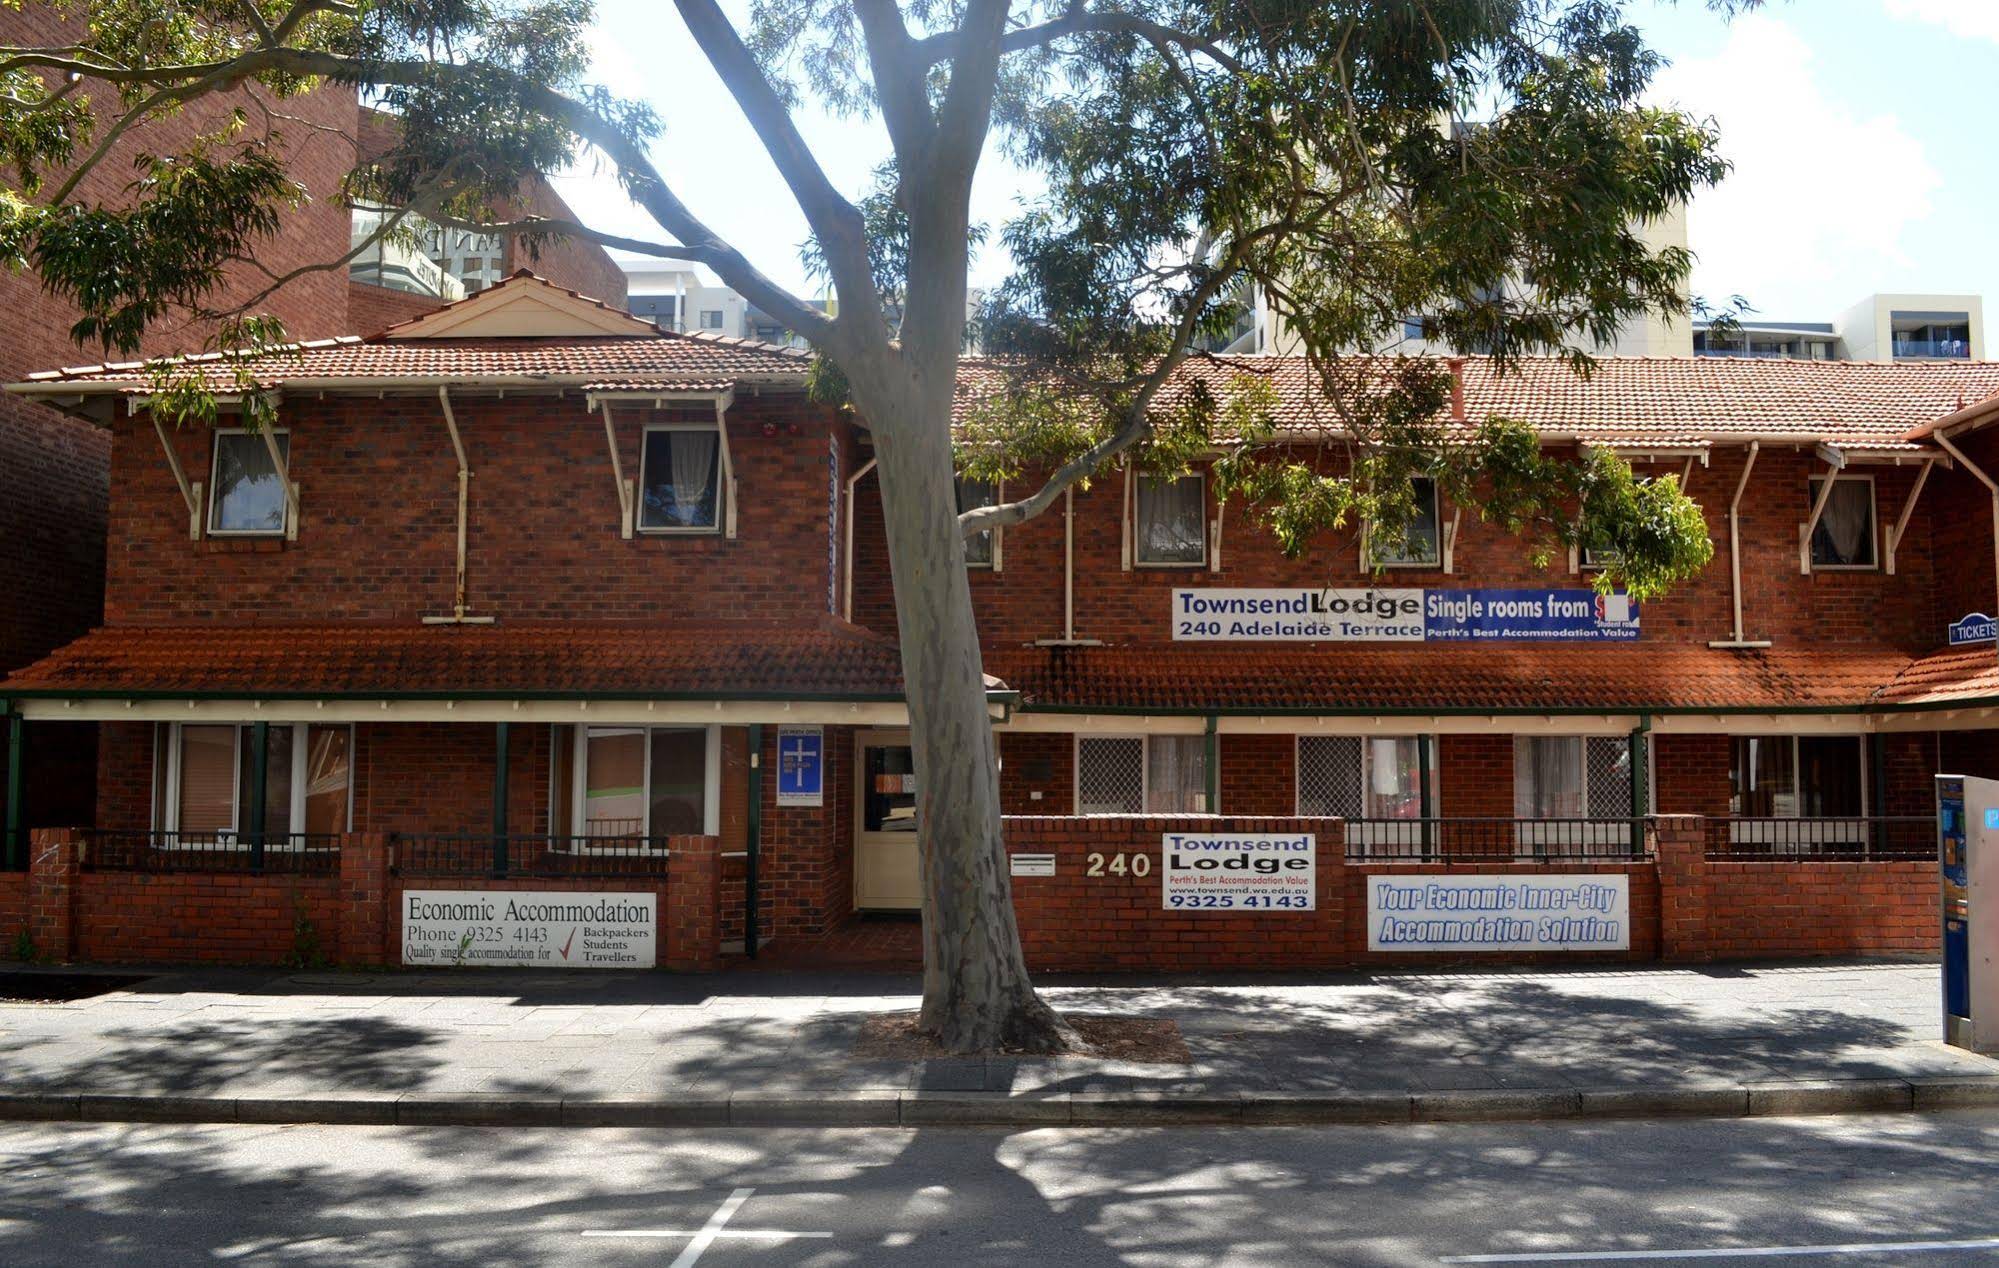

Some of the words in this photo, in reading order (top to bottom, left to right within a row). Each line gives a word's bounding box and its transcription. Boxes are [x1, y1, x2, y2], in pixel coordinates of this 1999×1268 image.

[1180, 593, 1307, 614] Townsend
[1311, 593, 1420, 619] Lodge
[1427, 595, 1483, 623] Single
[1488, 600, 1543, 618] rooms
[1548, 594, 1589, 618] from
[1180, 622, 1221, 636] 240
[1230, 621, 1331, 636] Adelaide
[1340, 622, 1423, 636] Terrace
[1427, 628, 1470, 637] Perth's
[1473, 628, 1498, 637] Best
[1502, 628, 1598, 637] Accommodation
[1602, 628, 1637, 638] Value
[1170, 836, 1308, 851] Townsend
[1087, 853, 1150, 876] 240
[1171, 854, 1310, 874] Lodge
[1170, 875, 1198, 885] Perth's
[1200, 876, 1217, 884] Best
[1219, 875, 1283, 885] Accommodation
[1285, 876, 1308, 884] Value
[1169, 886, 1308, 895] www.townsend.wa.edu.au
[1377, 884, 1424, 910] Your
[1425, 885, 1516, 910] Economic
[1519, 885, 1616, 913] Inner-City
[1170, 895, 1233, 907] 9325
[1243, 895, 1307, 907] 4143
[408, 897, 494, 921] Economic
[504, 899, 650, 923] Accommodation
[407, 925, 457, 942] Phone
[467, 926, 504, 942] 9325
[513, 927, 548, 942] 4143
[583, 926, 649, 938] Backpackers
[1379, 917, 1533, 943] Accommodation
[1538, 916, 1619, 943] Solution
[405, 943, 436, 961] Quality
[468, 944, 535, 960] accommodation
[538, 945, 551, 960] for
[583, 939, 628, 950] Students
[584, 951, 637, 963] Travellers
